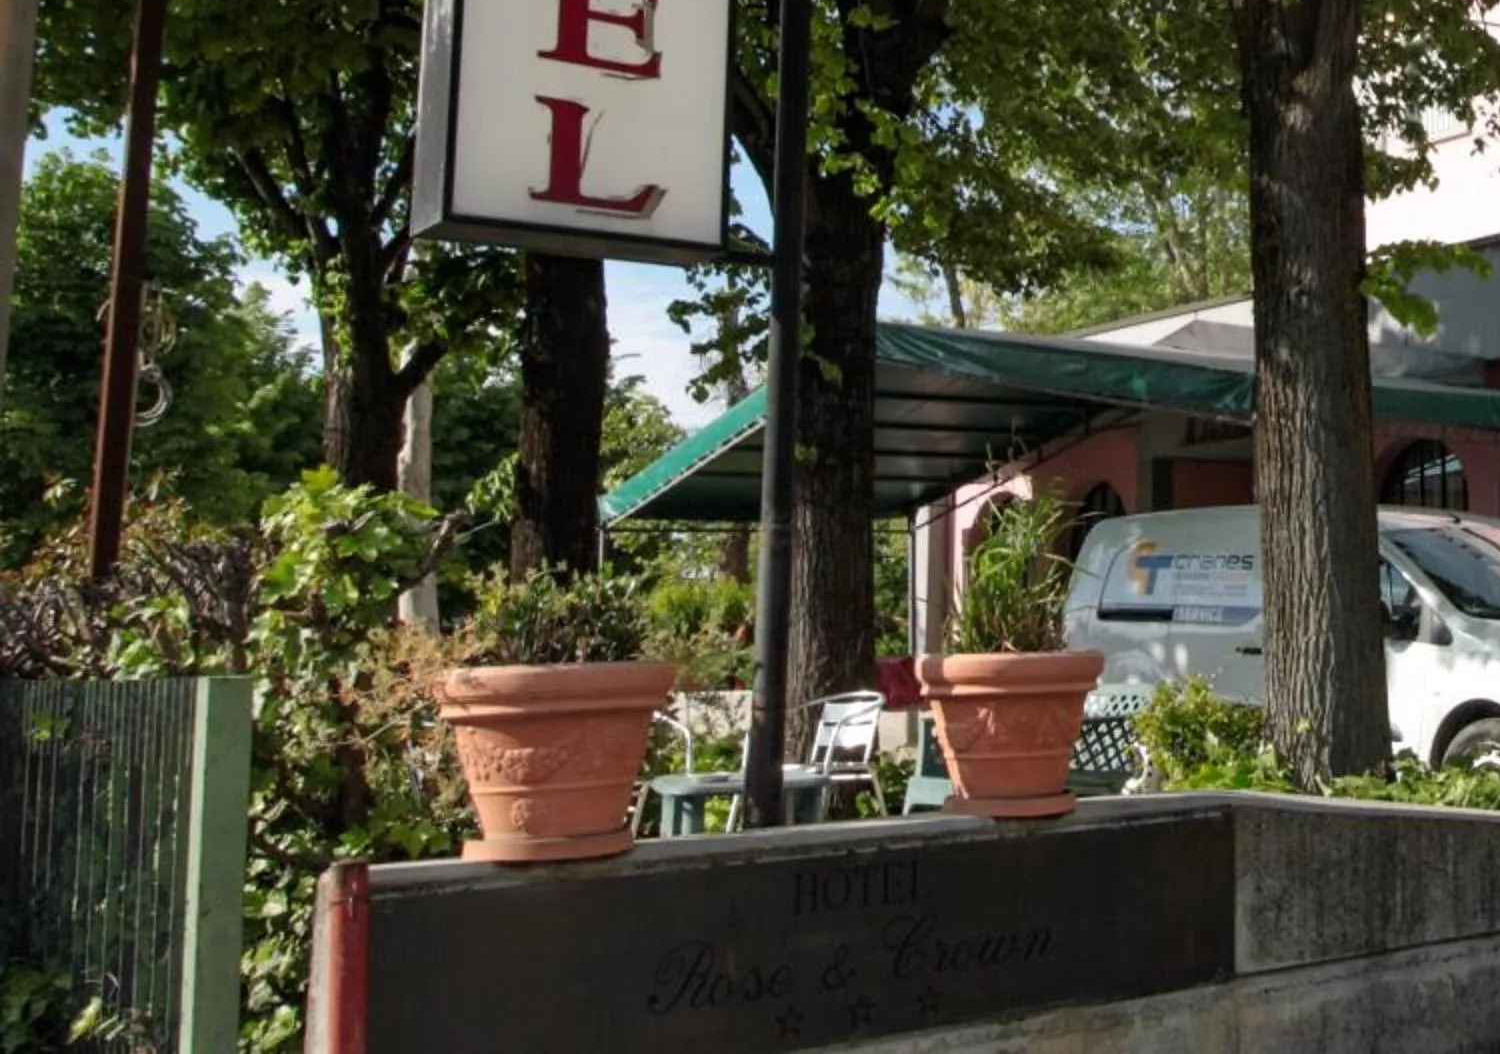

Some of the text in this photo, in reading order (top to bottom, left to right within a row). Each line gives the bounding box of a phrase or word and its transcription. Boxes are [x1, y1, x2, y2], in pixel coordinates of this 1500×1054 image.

[791, 859, 933, 914] HOTEL
[645, 911, 1058, 1016] Rose & Crown
